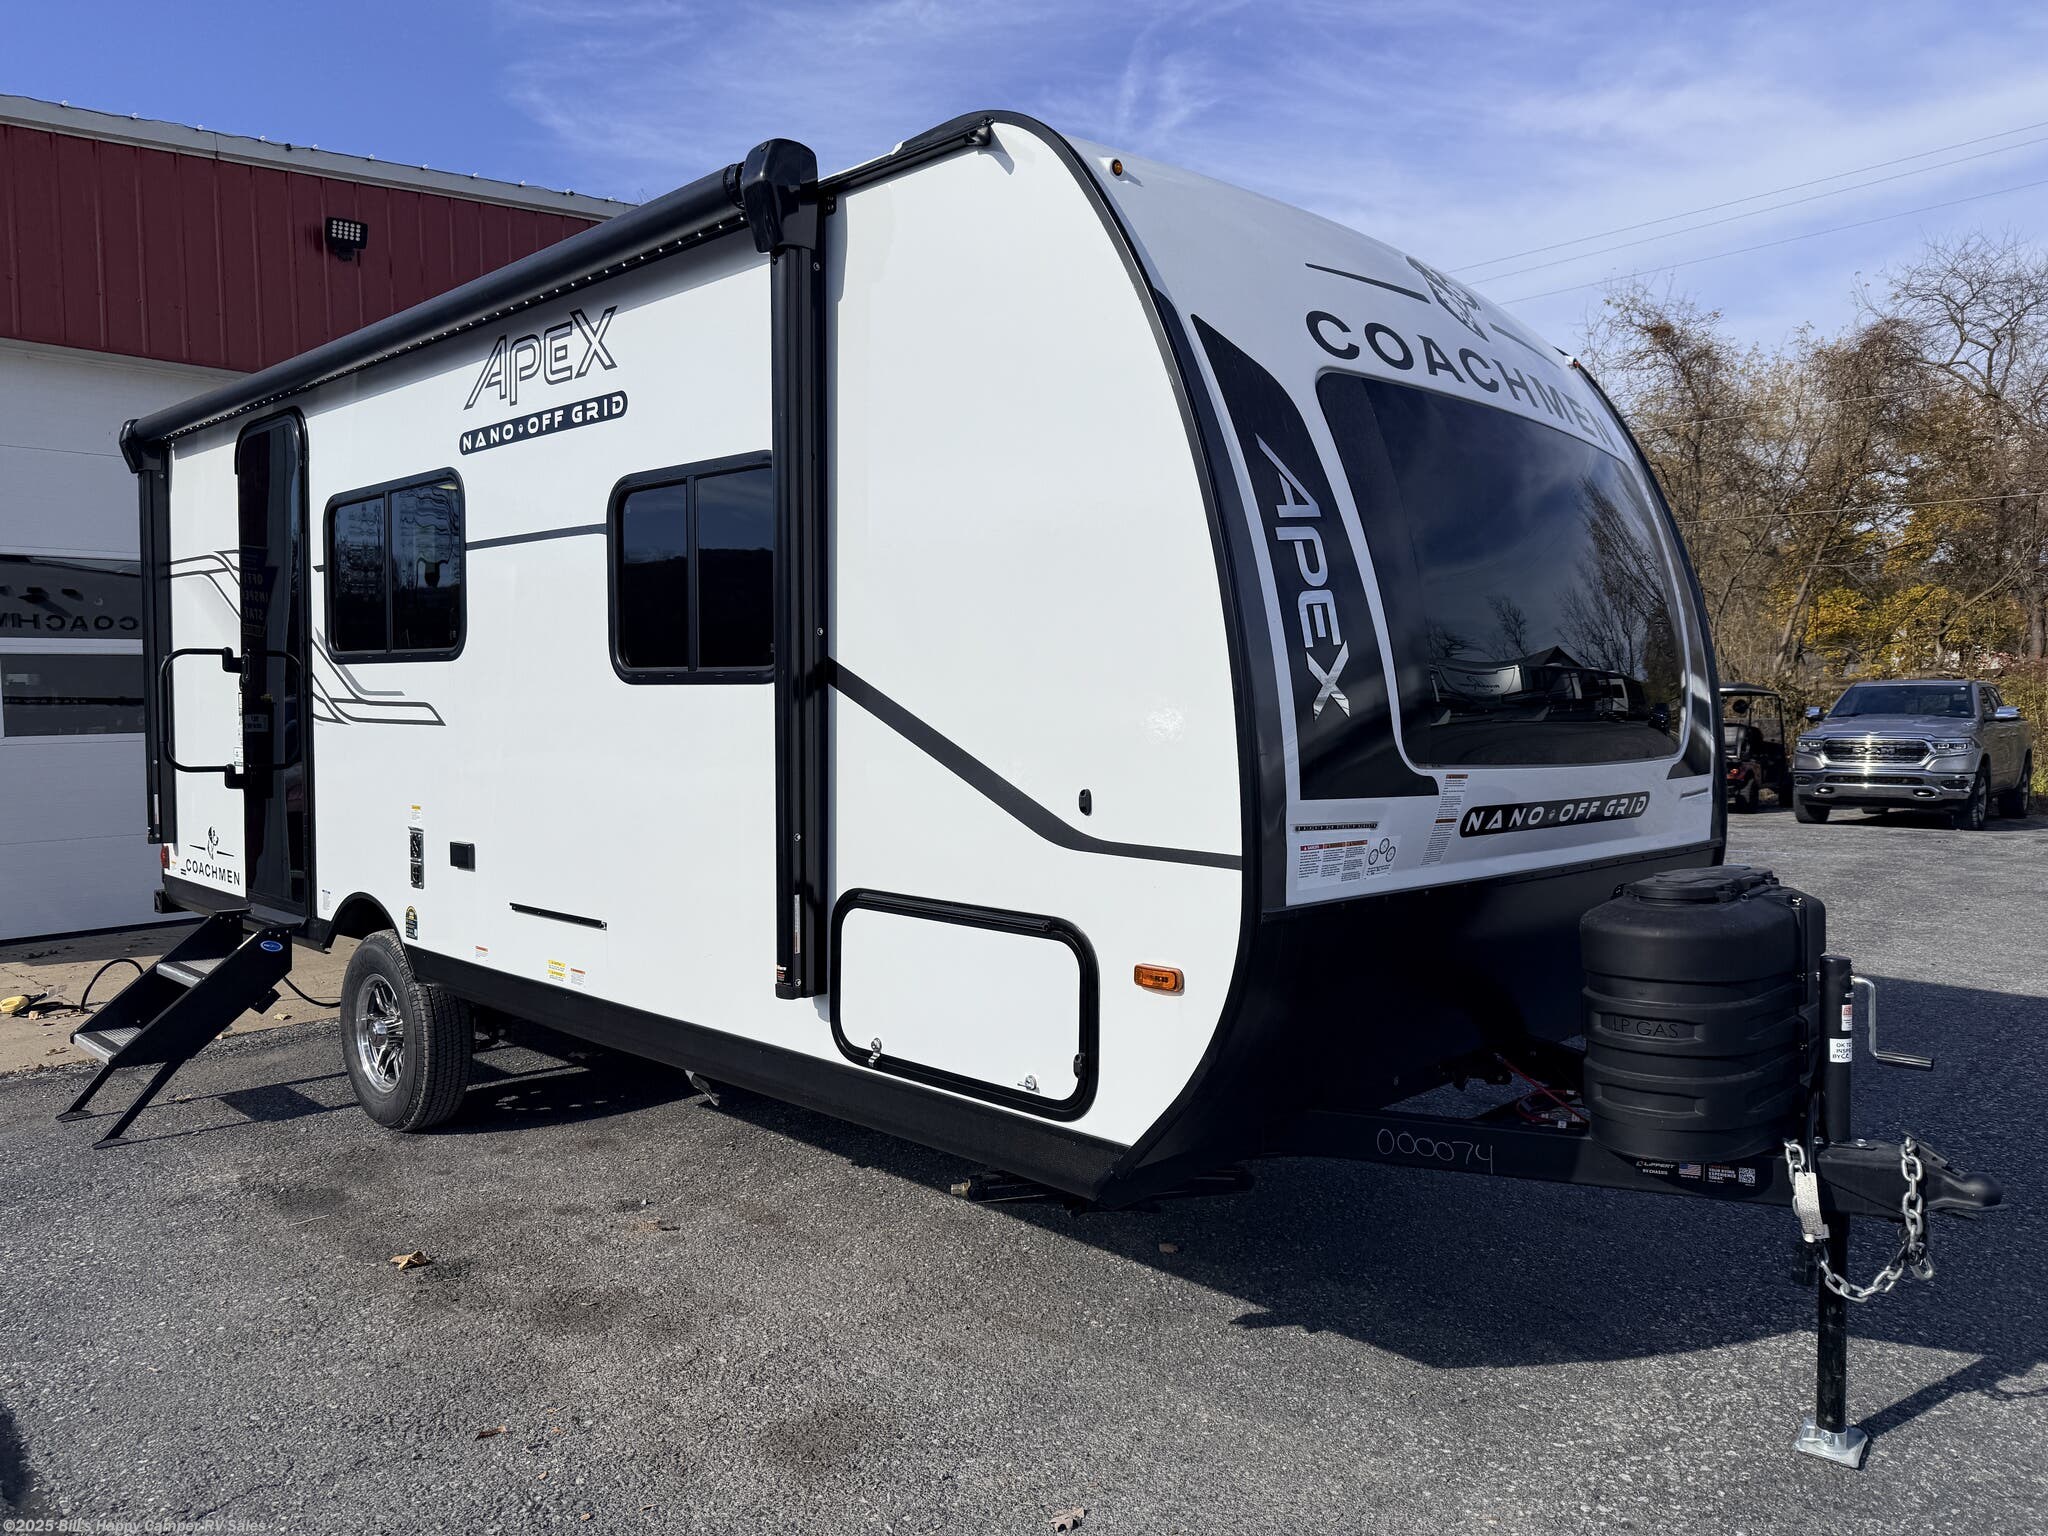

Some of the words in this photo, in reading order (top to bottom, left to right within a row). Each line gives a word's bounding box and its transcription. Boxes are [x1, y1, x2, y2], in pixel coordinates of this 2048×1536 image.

[463, 305, 618, 411] APEX
[1306, 311, 1618, 450] COACHMEN
[462, 424, 514, 451] NANO
[527, 410, 564, 434] OFF
[572, 395, 624, 423] GRID
[1255, 432, 1350, 721] APEX
[1465, 806, 1545, 833] NANO
[1559, 801, 1601, 822] OFF
[1604, 796, 1647, 817] GRID
[185, 858, 240, 886] COACHMEN
[1613, 1018, 1630, 1033] LP
[1636, 1021, 1678, 1038] GAS
[1376, 1128, 1494, 1175] 000074
